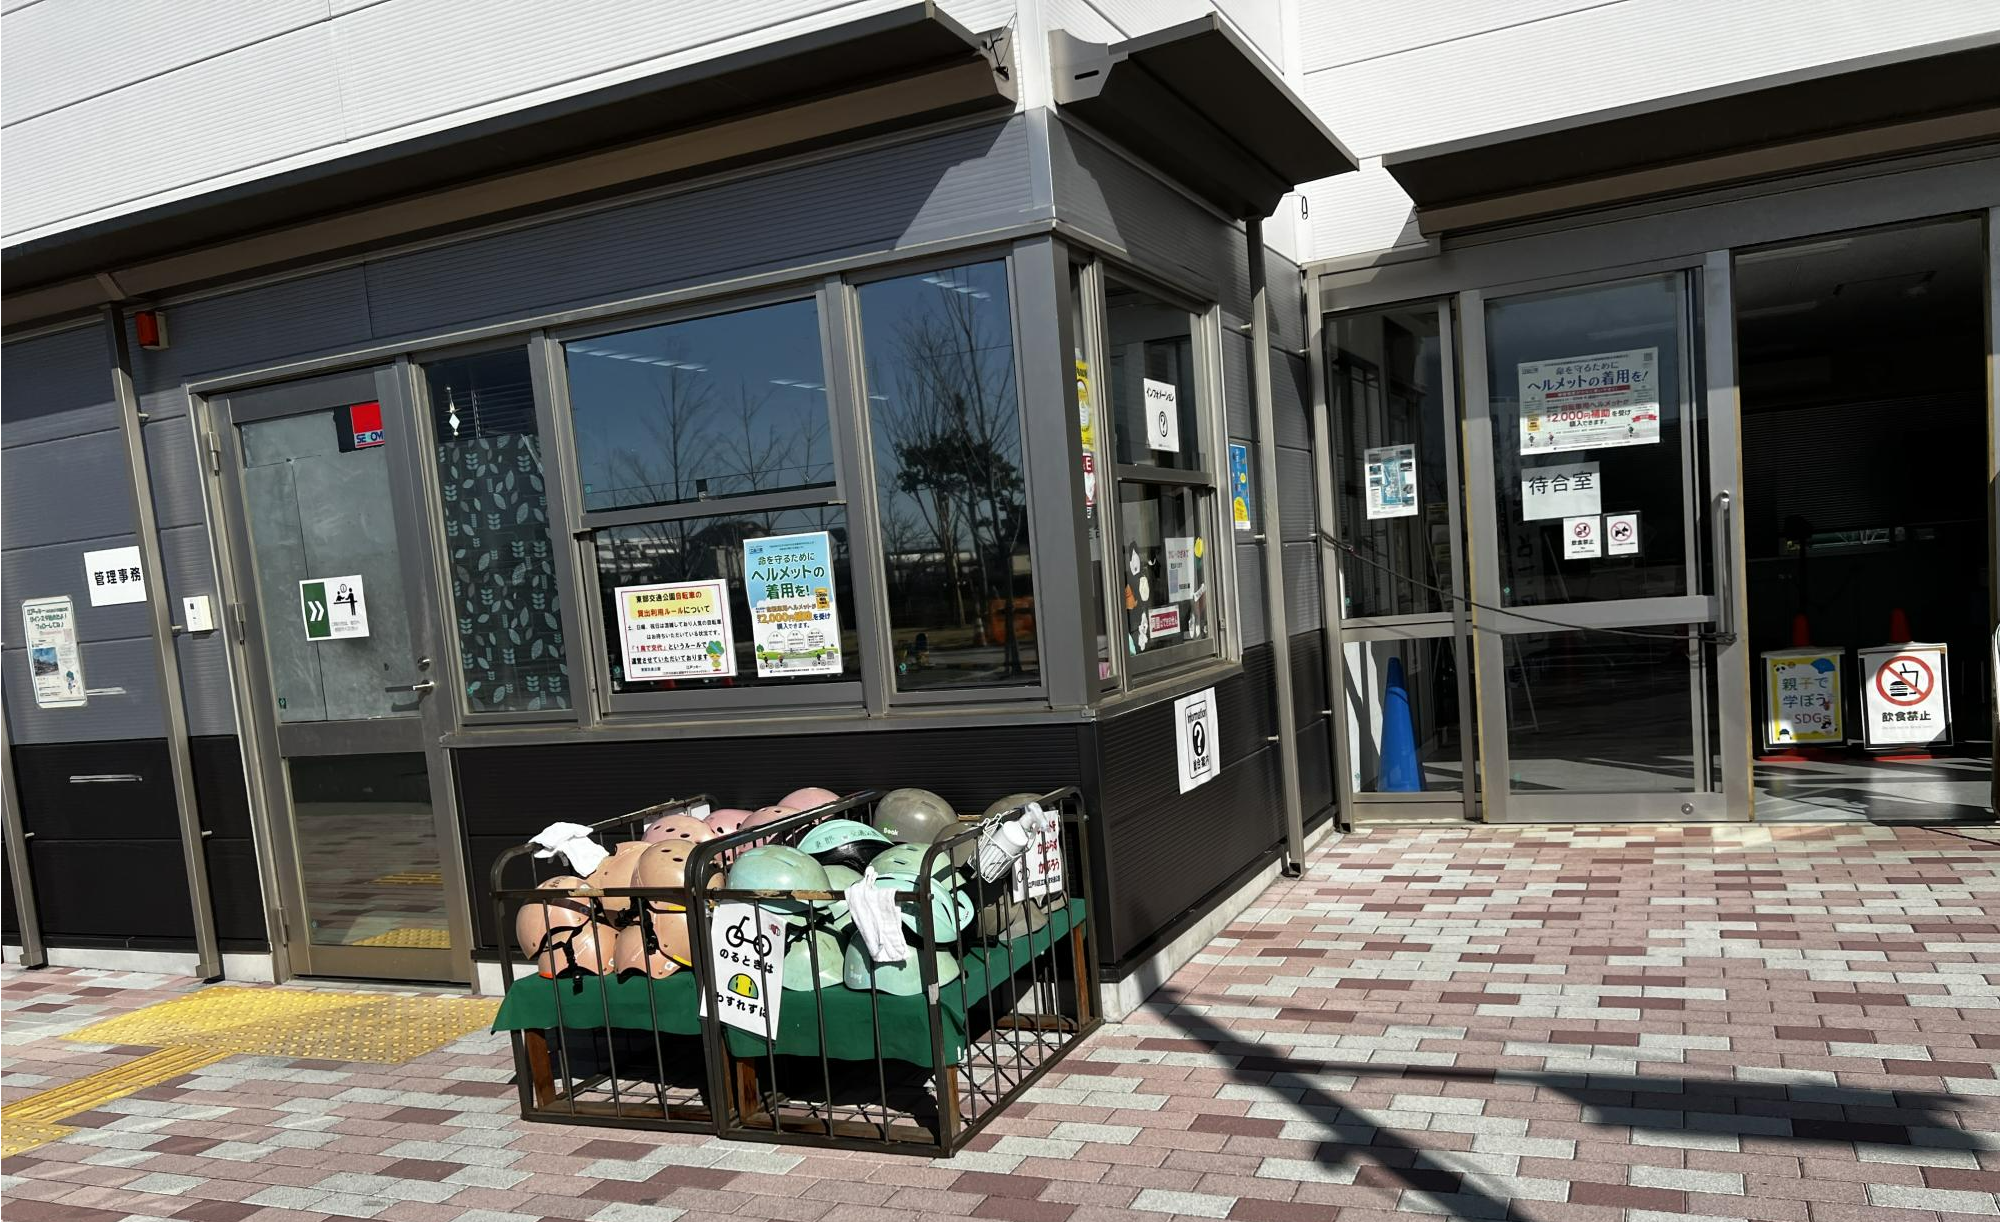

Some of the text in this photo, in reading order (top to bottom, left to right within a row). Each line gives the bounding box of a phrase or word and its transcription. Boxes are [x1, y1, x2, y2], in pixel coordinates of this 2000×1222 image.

[1529, 471, 1593, 495] 待合室
[758, 552, 815, 565] 命を守るために
[94, 567, 141, 586] 管理事務
[752, 564, 825, 582] ヘルメットの
[636, 591, 702, 603] 東部交通公園自転車の
[765, 583, 810, 600] 着用を!
[637, 605, 710, 618] 貸出利用ルールについて
[1782, 676, 1828, 691] 親子で
[1783, 693, 1827, 708] 学ぼう
[1794, 712, 1830, 725] SDGs
[1881, 710, 1931, 722] 飲食禁止
[719, 948, 774, 974] のるときは
